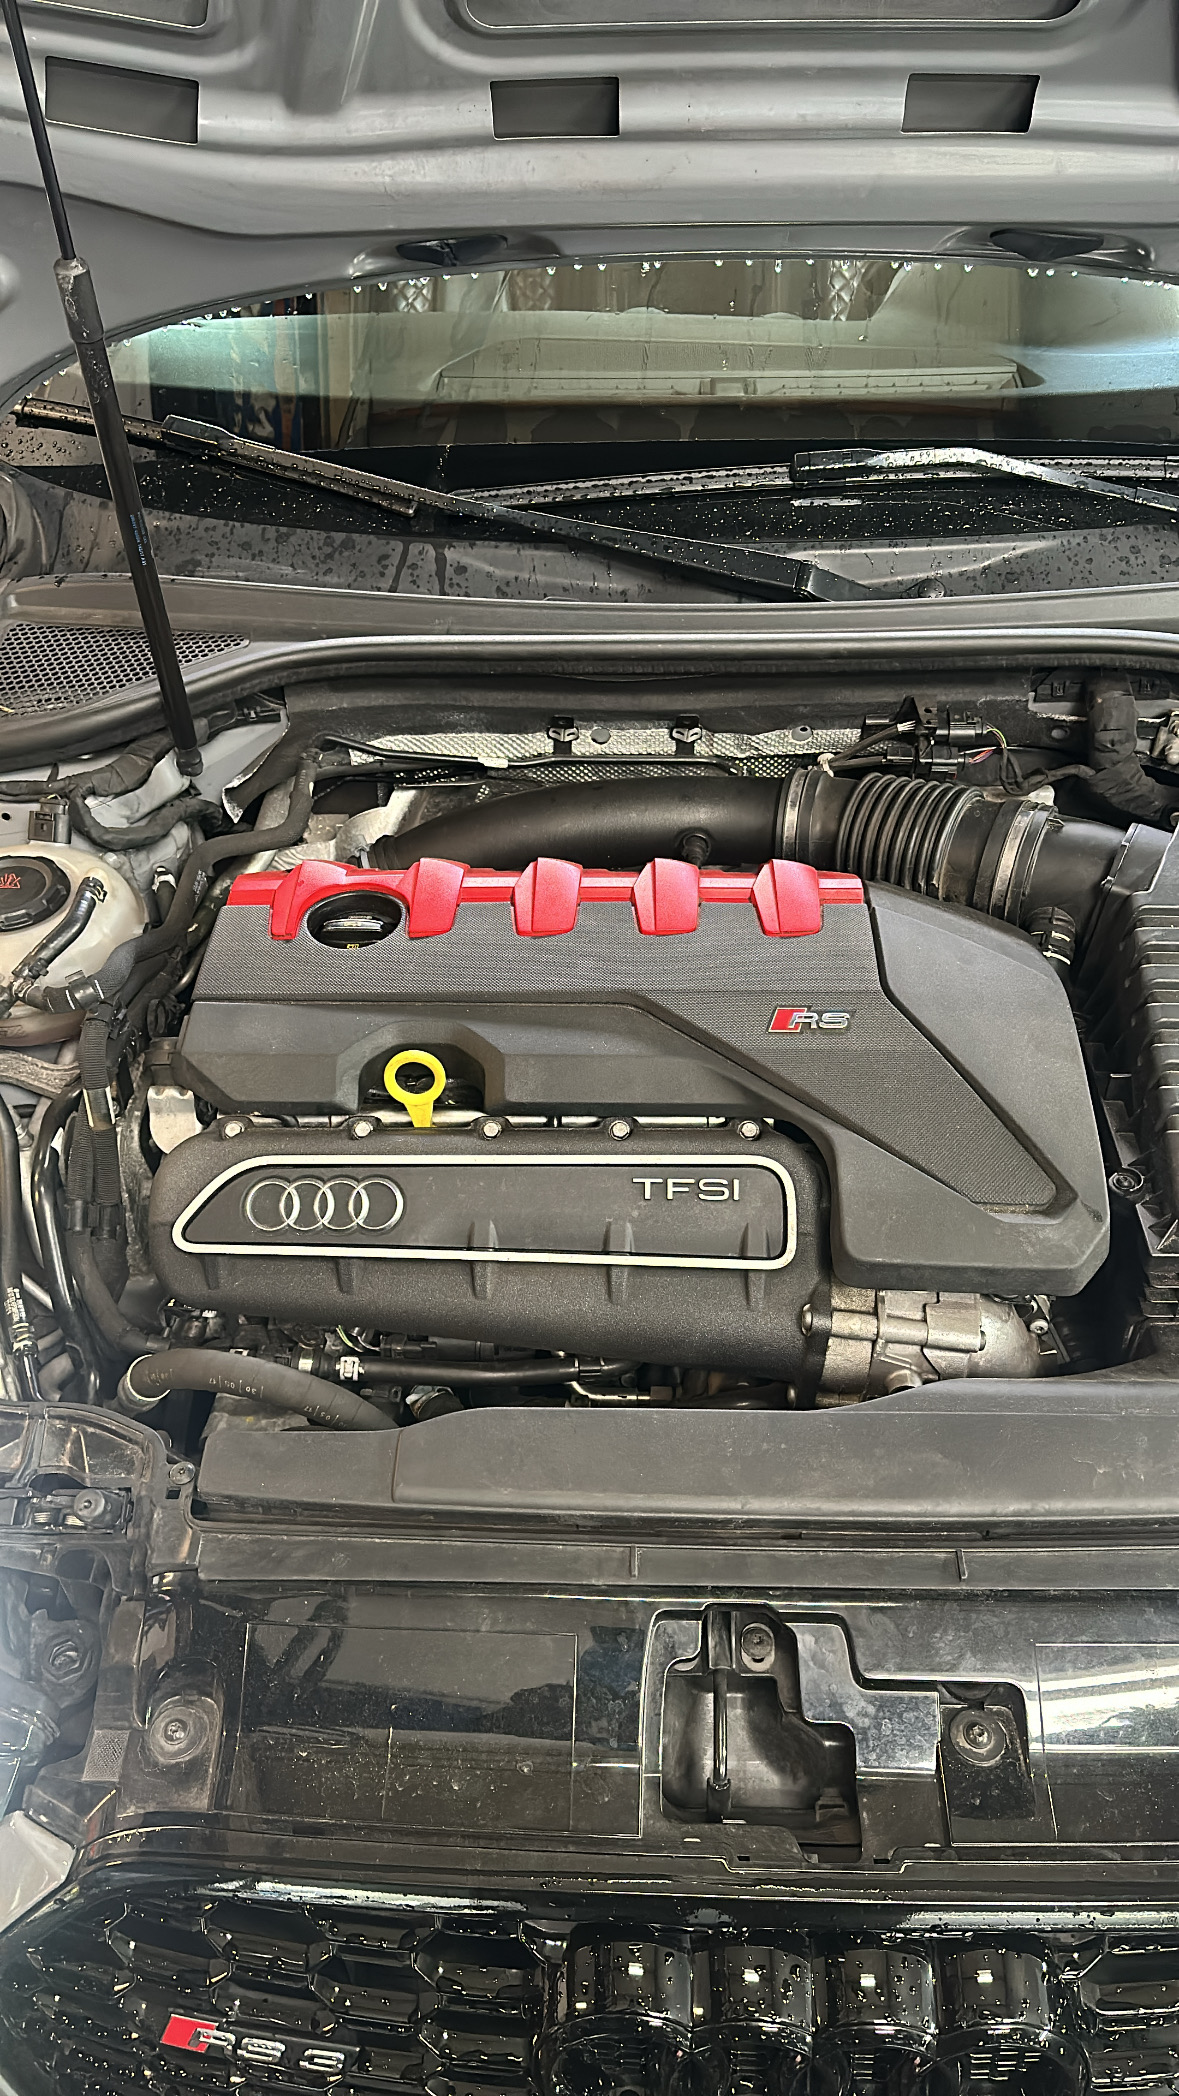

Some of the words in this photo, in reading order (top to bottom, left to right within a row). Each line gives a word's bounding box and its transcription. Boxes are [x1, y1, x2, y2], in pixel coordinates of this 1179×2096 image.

[787, 1010, 852, 1029] RS
[632, 1178, 740, 1201] TFSI
[188, 2027, 286, 2064] RS
[299, 2048, 345, 2073] 3
